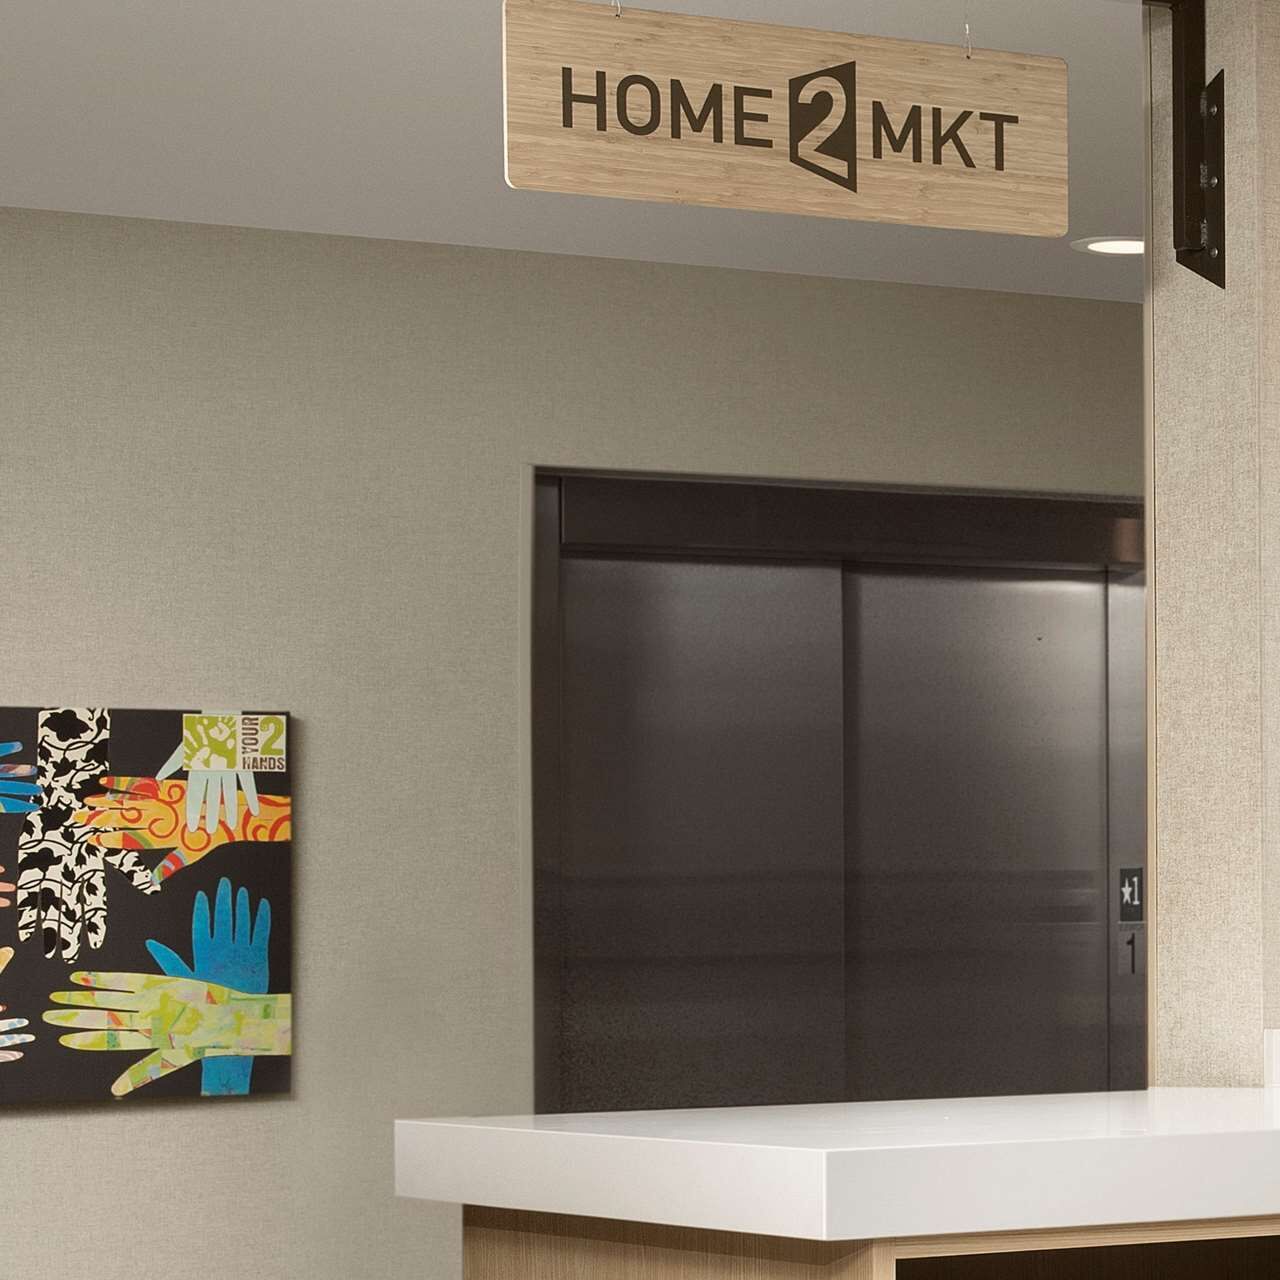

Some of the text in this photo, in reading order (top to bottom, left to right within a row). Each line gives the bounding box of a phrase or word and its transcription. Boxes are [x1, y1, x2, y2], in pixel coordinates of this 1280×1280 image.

[561, 66, 773, 148] HOME
[872, 100, 1019, 171] MKT
[242, 717, 259, 754] YOUR
[261, 716, 285, 756] 2
[242, 756, 285, 770] HANDS
